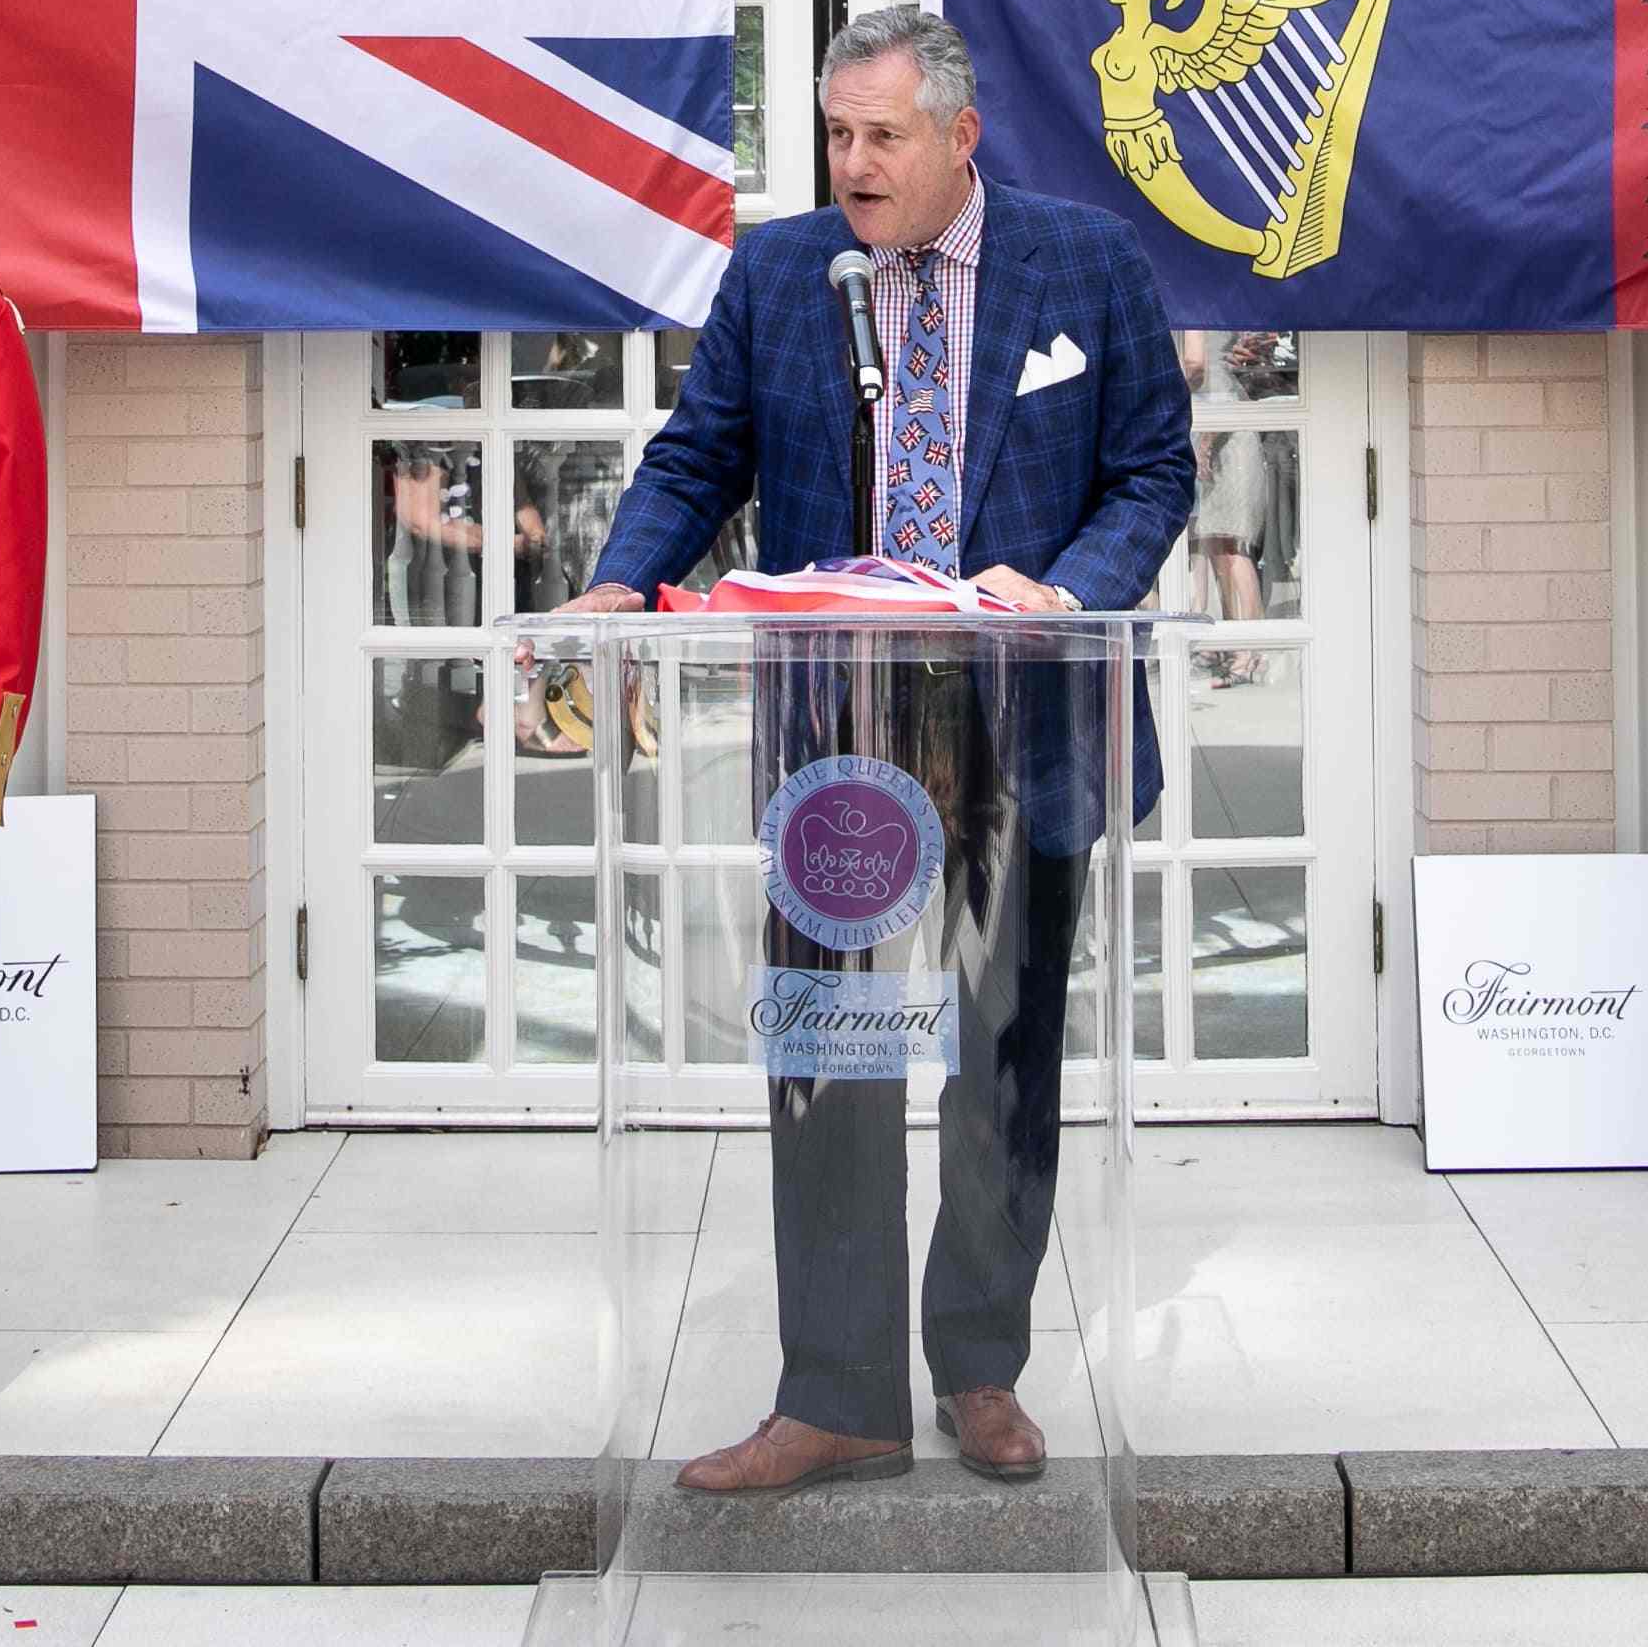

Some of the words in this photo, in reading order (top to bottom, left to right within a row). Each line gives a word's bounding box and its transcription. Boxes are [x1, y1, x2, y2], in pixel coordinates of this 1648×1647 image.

[779, 762, 827, 800] THE
[836, 757, 934, 817] QUEEN'S
[760, 822, 822, 939] PLATINUM
[832, 900, 924, 947] JUBILEE
[916, 842, 942, 893] 2022
[1443, 960, 1643, 1025] Fairmont
[750, 970, 955, 1037] Fairmont
[0, 1006, 31, 1022] D.C.
[1477, 1027, 1584, 1041] WASHINGTON,
[1589, 1027, 1616, 1040] D.C.
[783, 1041, 893, 1057] WASHINGTON,
[898, 1042, 926, 1056] D.C.
[1507, 1047, 1586, 1057] GEORGETOWN
[813, 1063, 894, 1074] GEORGETOWN
